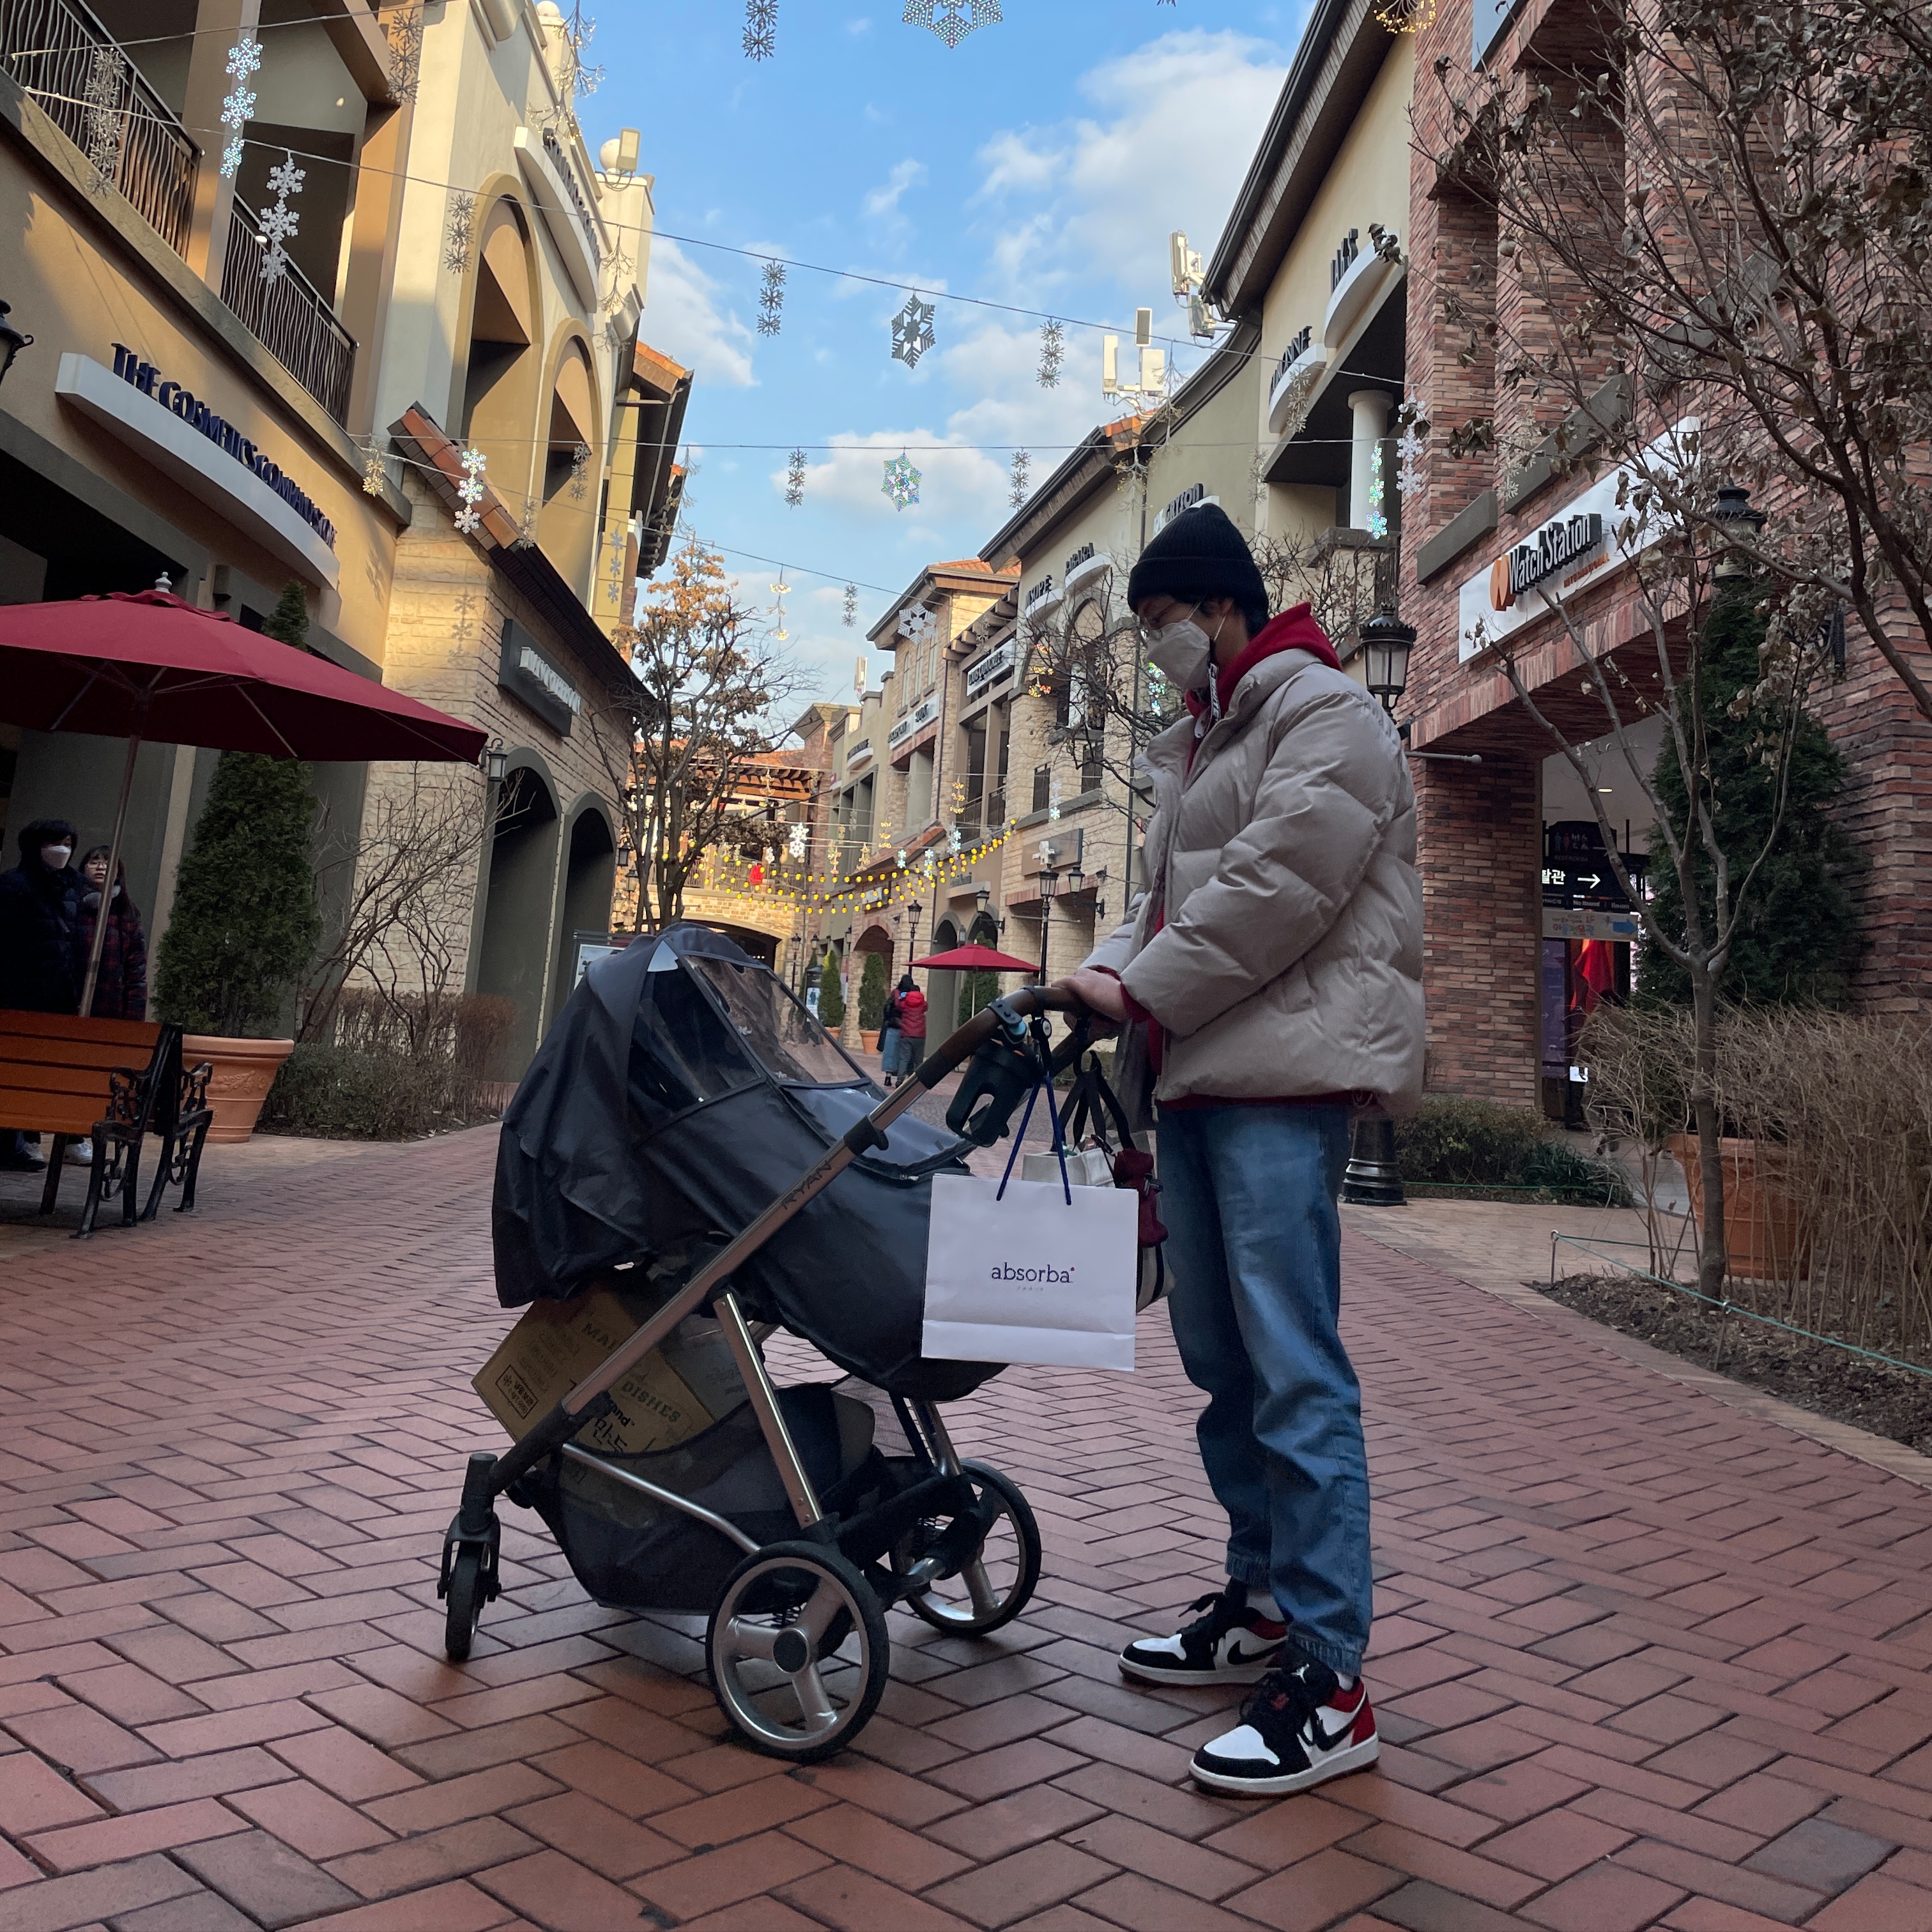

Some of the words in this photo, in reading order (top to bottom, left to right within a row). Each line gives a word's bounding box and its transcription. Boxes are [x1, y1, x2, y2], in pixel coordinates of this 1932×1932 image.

[111, 343, 161, 402] THE
[1509, 530, 1544, 595] Watch
[1545, 513, 1602, 571] Station
[991, 1262, 1071, 1284] absorba
[581, 1322, 616, 1351] MAI
[621, 1380, 682, 1423] DISHES
